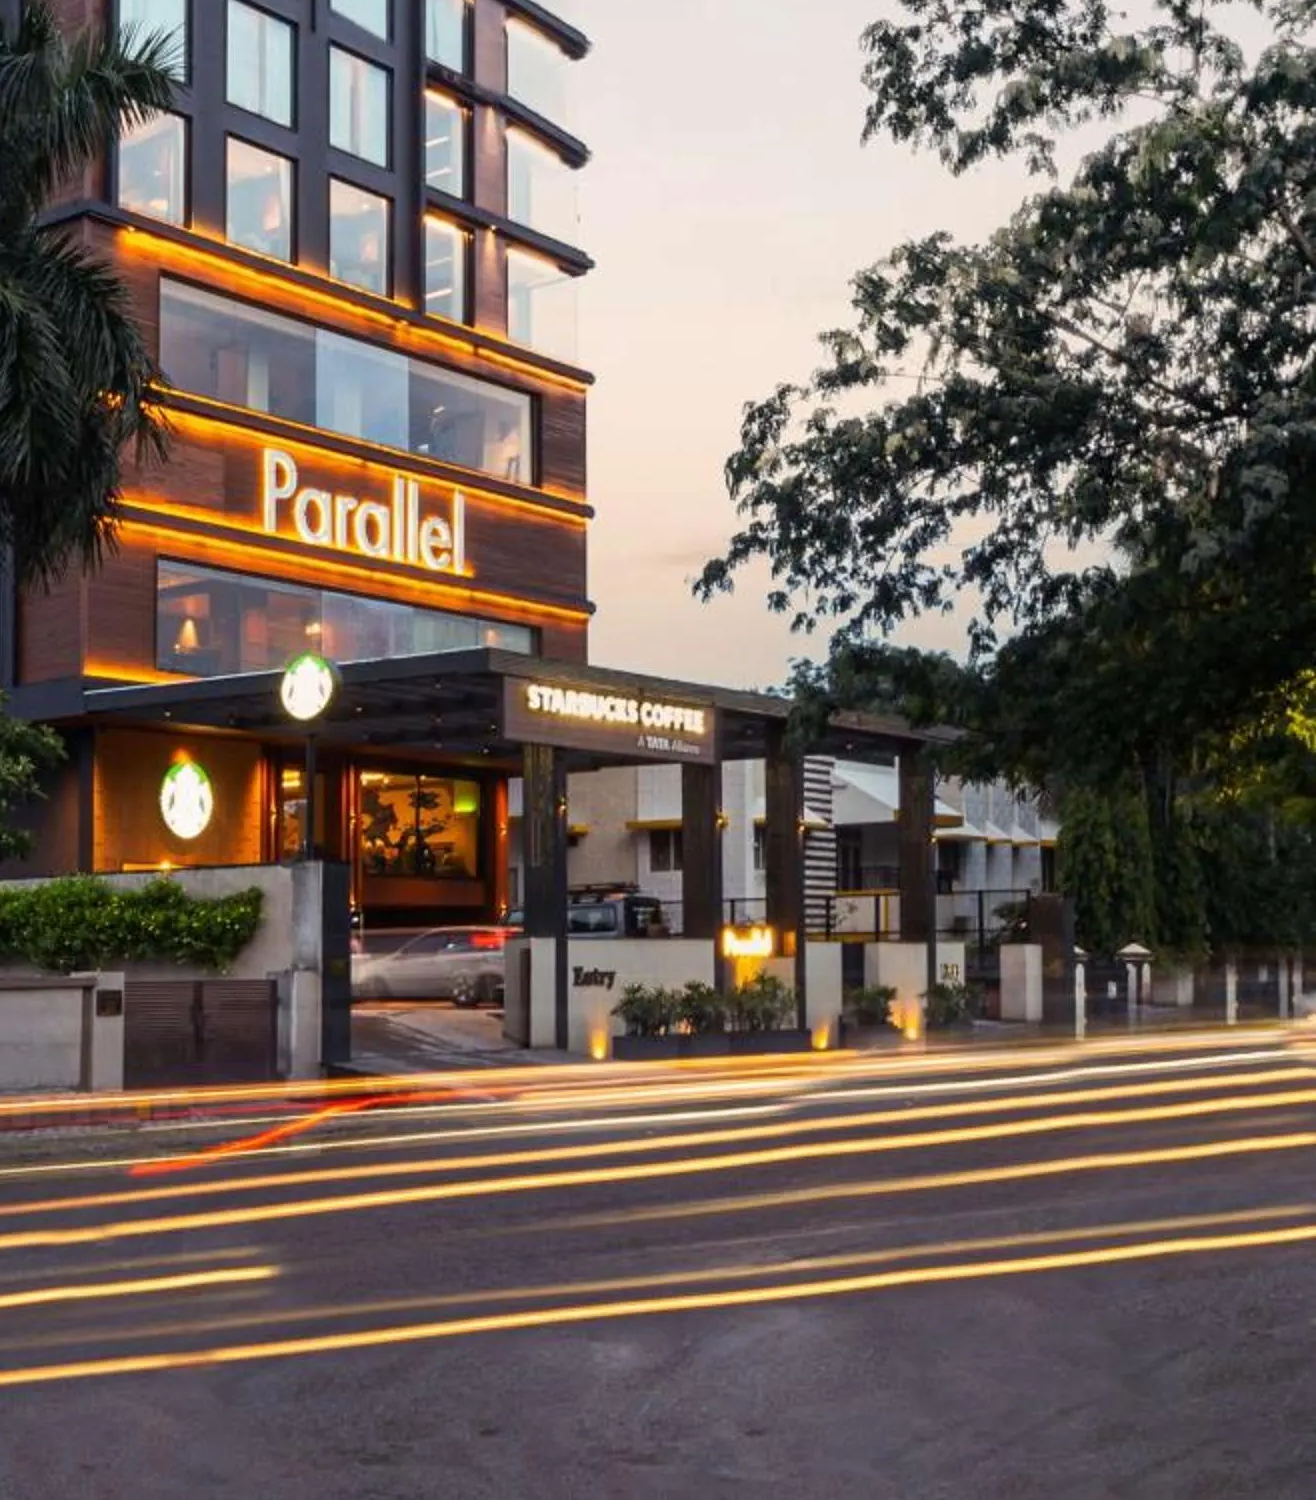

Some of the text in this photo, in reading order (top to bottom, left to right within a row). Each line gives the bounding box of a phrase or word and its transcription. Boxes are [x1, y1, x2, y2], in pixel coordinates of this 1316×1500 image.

[264, 448, 465, 575] Parallel
[527, 683, 704, 734] STARBUCKS COFFEE
[572, 966, 616, 991] Entry
